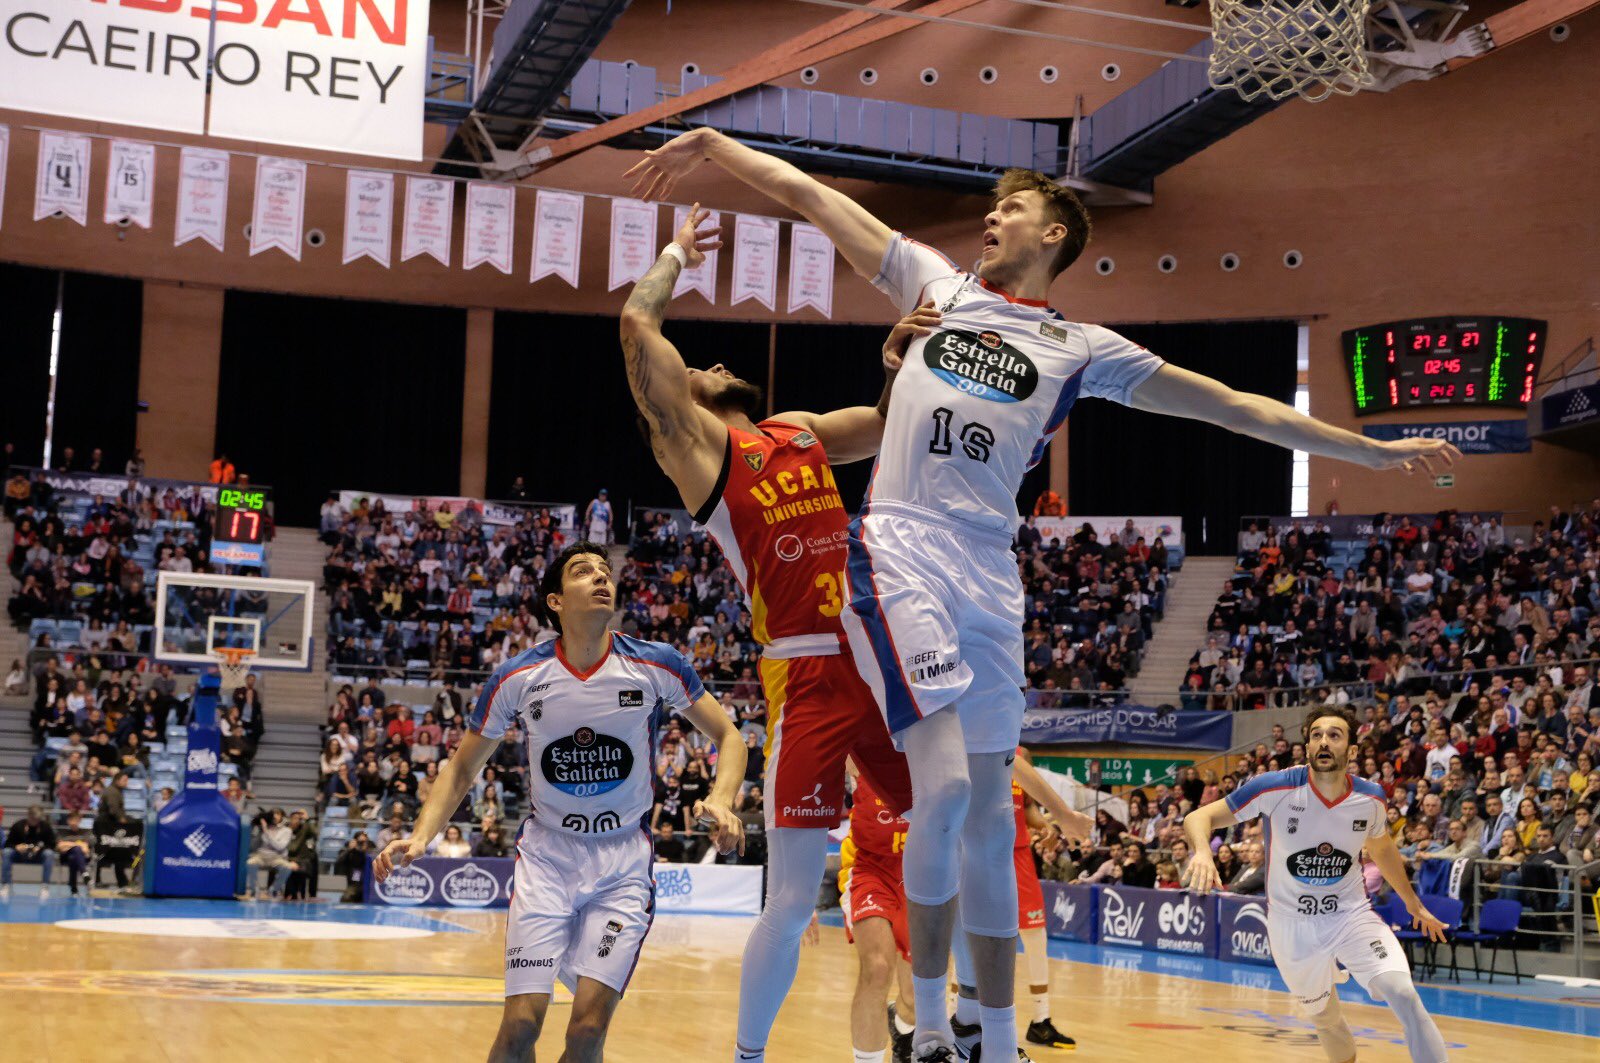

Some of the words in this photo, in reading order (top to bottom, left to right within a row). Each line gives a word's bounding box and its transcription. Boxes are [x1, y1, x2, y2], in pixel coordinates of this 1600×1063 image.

[5, 12, 260, 85] CAEIRO
[285, 50, 404, 104] REY
[55, 165, 72, 188] 4
[123, 172, 138, 186] 15
[1413, 334, 1431, 350] 27
[1437, 335, 1448, 348] 2
[1461, 332, 1480, 347] 27
[939, 333, 1027, 377] Estrella
[939, 352, 1017, 394] Galicia
[1424, 359, 1461, 374] 02:45
[1411, 386, 1420, 397] 4
[1465, 383, 1474, 396] 5
[1418, 425, 1491, 442] cenor
[750, 464, 838, 507] UCAM
[220, 489, 265, 509] 02:45
[763, 493, 844, 525] UNIVERSIDA
[230, 512, 259, 540] 17
[806, 537, 832, 548] Costa
[815, 571, 845, 618] 3
[914, 650, 938, 664] GEFF
[531, 683, 552, 693] GEFF
[1116, 710, 1144, 726] DO
[1148, 712, 1177, 729] SAR
[551, 745, 622, 764] Estrella
[555, 764, 619, 782] Galicia
[783, 805, 836, 817] Primafrio
[1295, 854, 1347, 868] Estrella
[1296, 865, 1343, 877] Galicia
[449, 875, 492, 889] Estrella
[449, 886, 490, 899] Galicia
